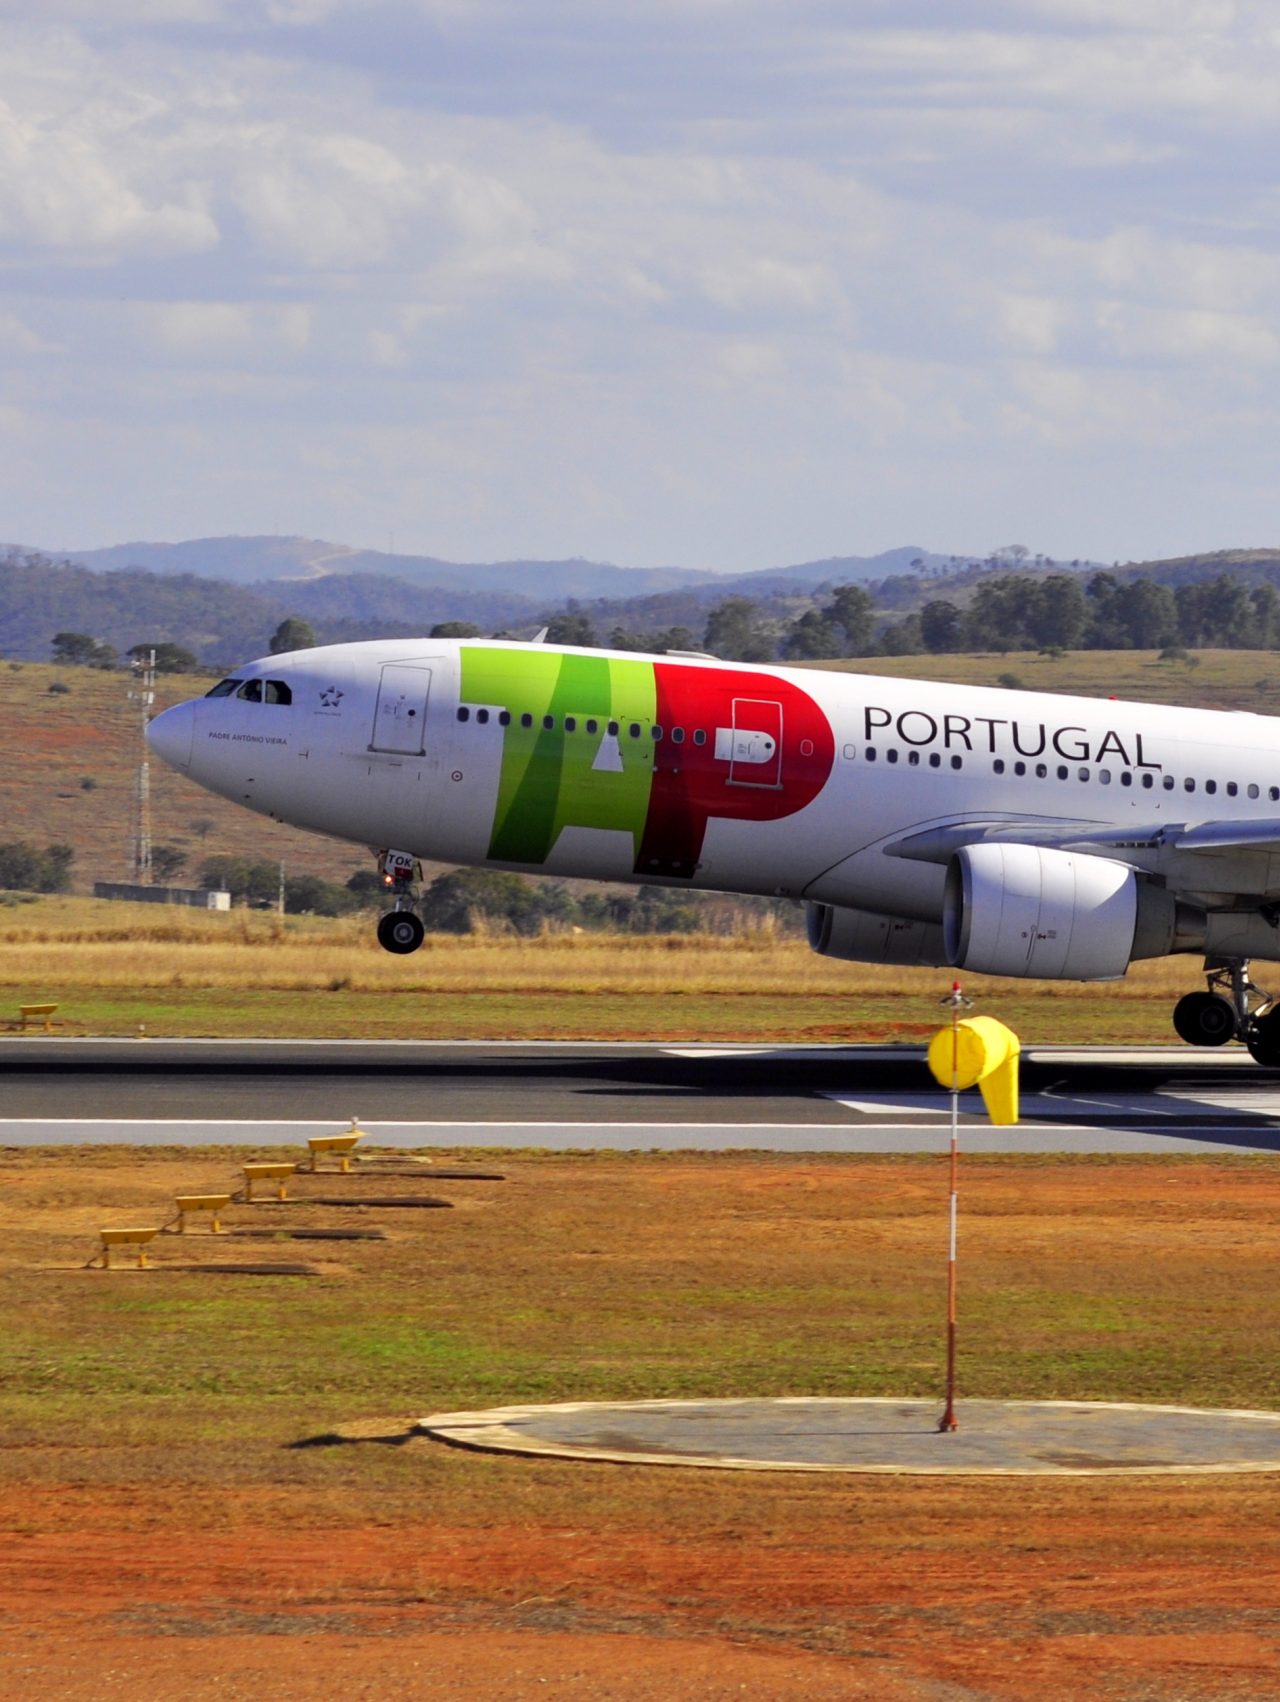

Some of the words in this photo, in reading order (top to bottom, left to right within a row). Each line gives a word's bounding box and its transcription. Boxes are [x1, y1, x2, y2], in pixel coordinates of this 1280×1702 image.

[459, 646, 835, 879] TAP
[864, 706, 1162, 768] PORTUGAL
[388, 854, 413, 868] TOK
